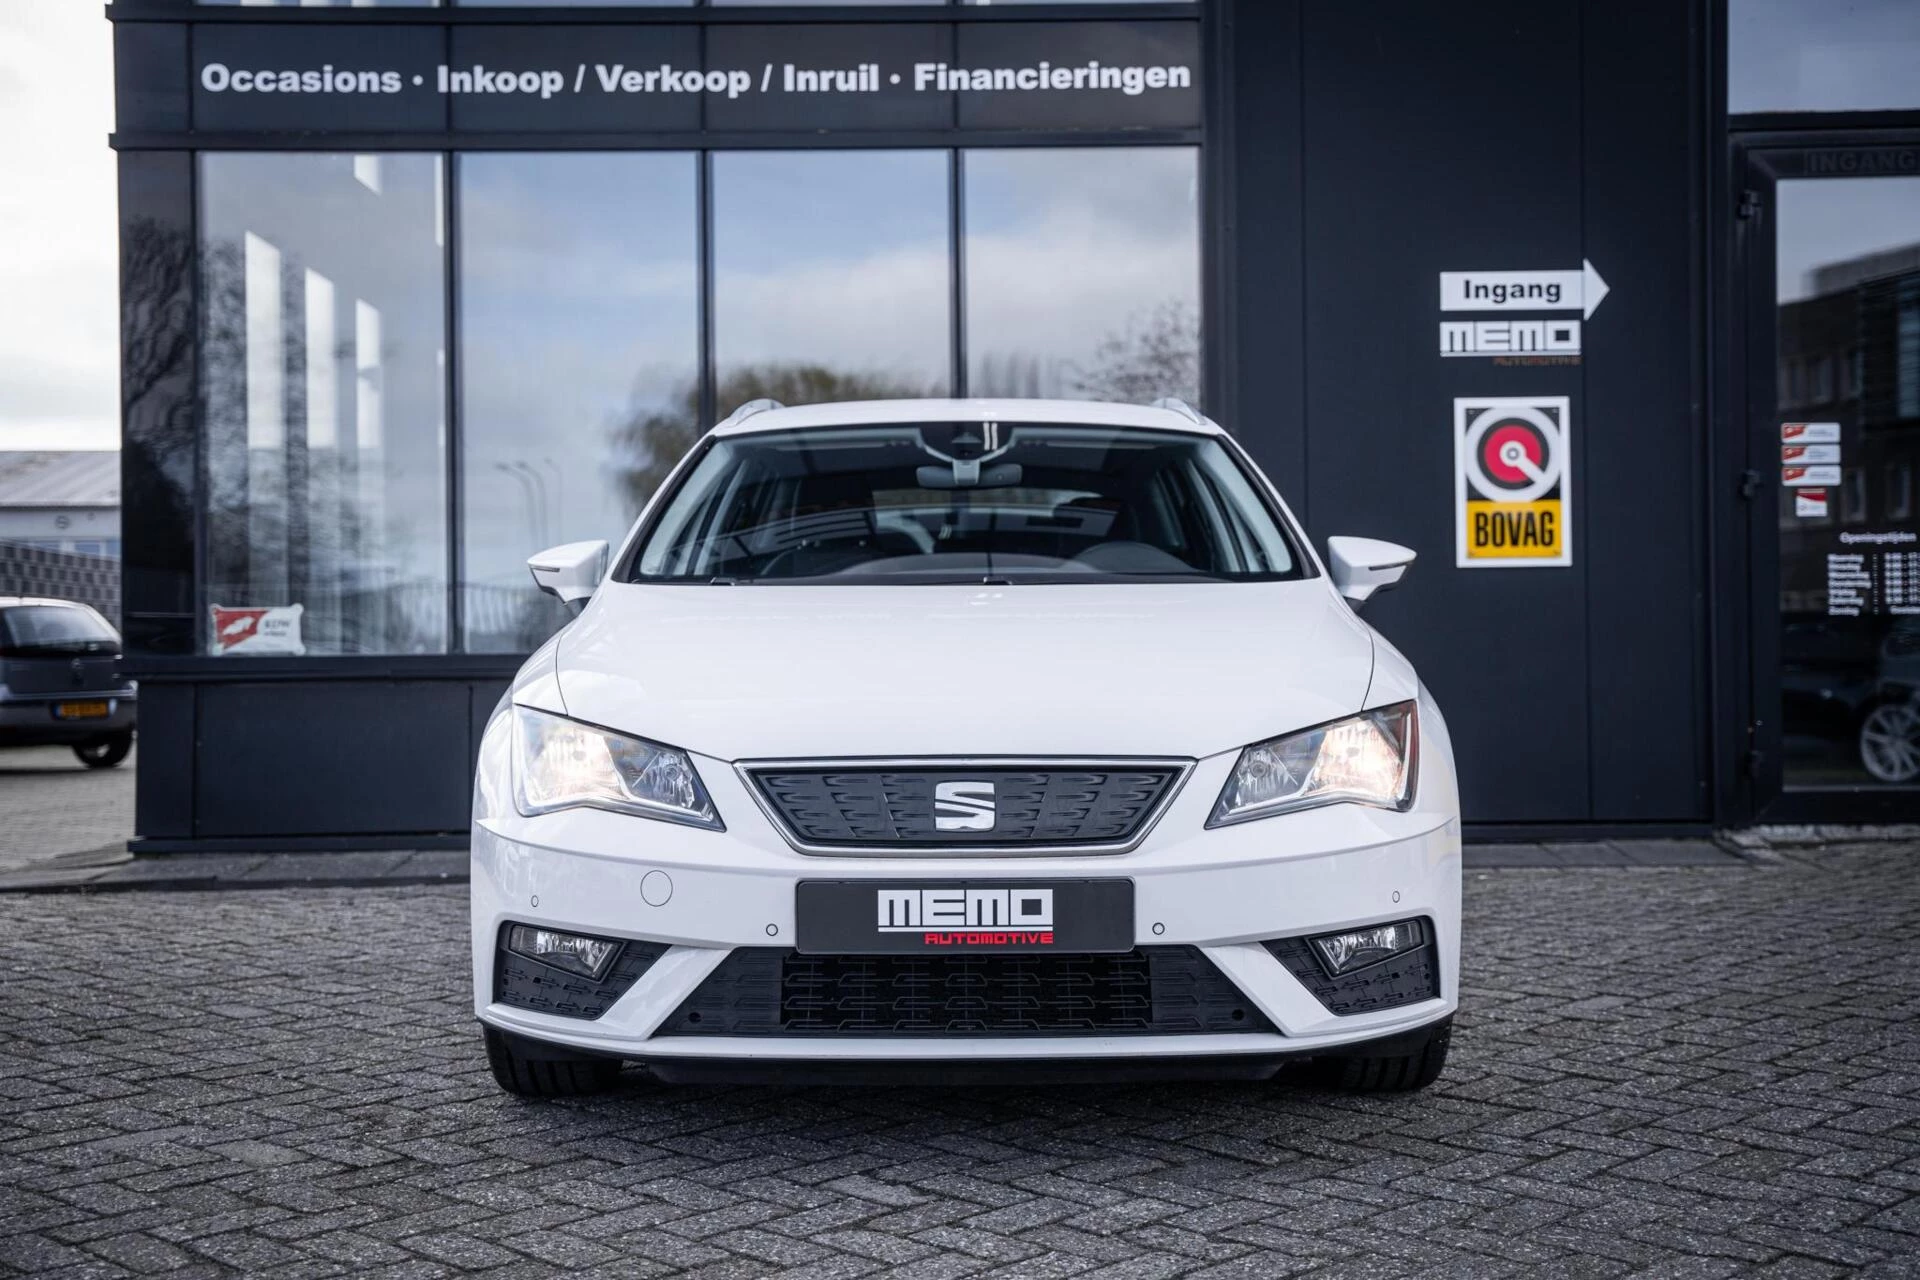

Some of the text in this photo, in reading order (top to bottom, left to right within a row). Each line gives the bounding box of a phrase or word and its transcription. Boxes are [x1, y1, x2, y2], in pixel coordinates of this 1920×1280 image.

[201, 63, 402, 93] Occasions
[437, 65, 564, 99] Inkoop
[595, 64, 751, 99] Verkoop
[783, 63, 880, 92] Inruil
[914, 60, 1191, 96] Financieringen
[1464, 279, 1562, 304] Ingang
[1439, 319, 1582, 353] MEMO
[1475, 511, 1554, 548] BOVAG
[877, 888, 1054, 927] MEMO
[924, 932, 1054, 945] AUTOMOTIVE
